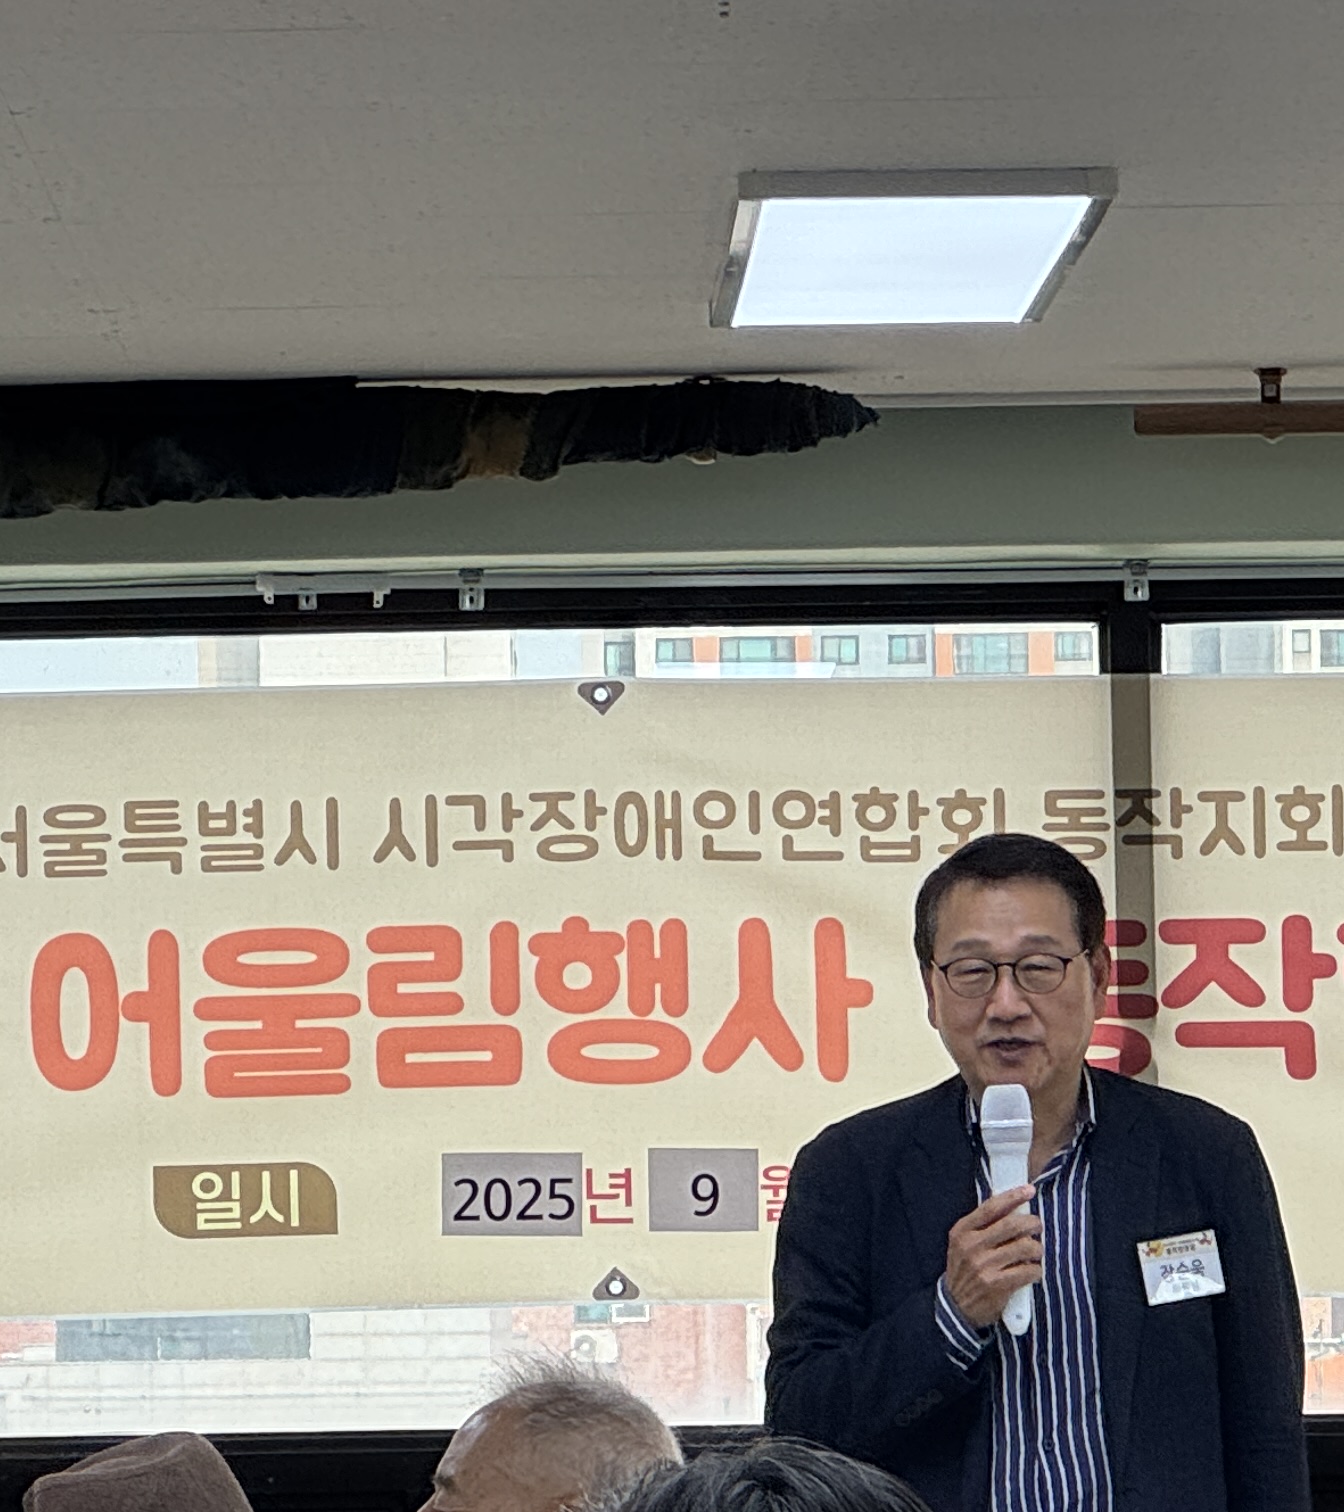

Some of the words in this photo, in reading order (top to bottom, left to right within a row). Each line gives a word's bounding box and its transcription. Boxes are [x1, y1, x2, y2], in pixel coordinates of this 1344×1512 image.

[373, 786, 1006, 869] 시각장애인연합회
[1042, 783, 1344, 861] 동작지회
[30, 915, 874, 1099] 어울림행사
[190, 1168, 301, 1229] 일시
[691, 1172, 721, 1218] 9
